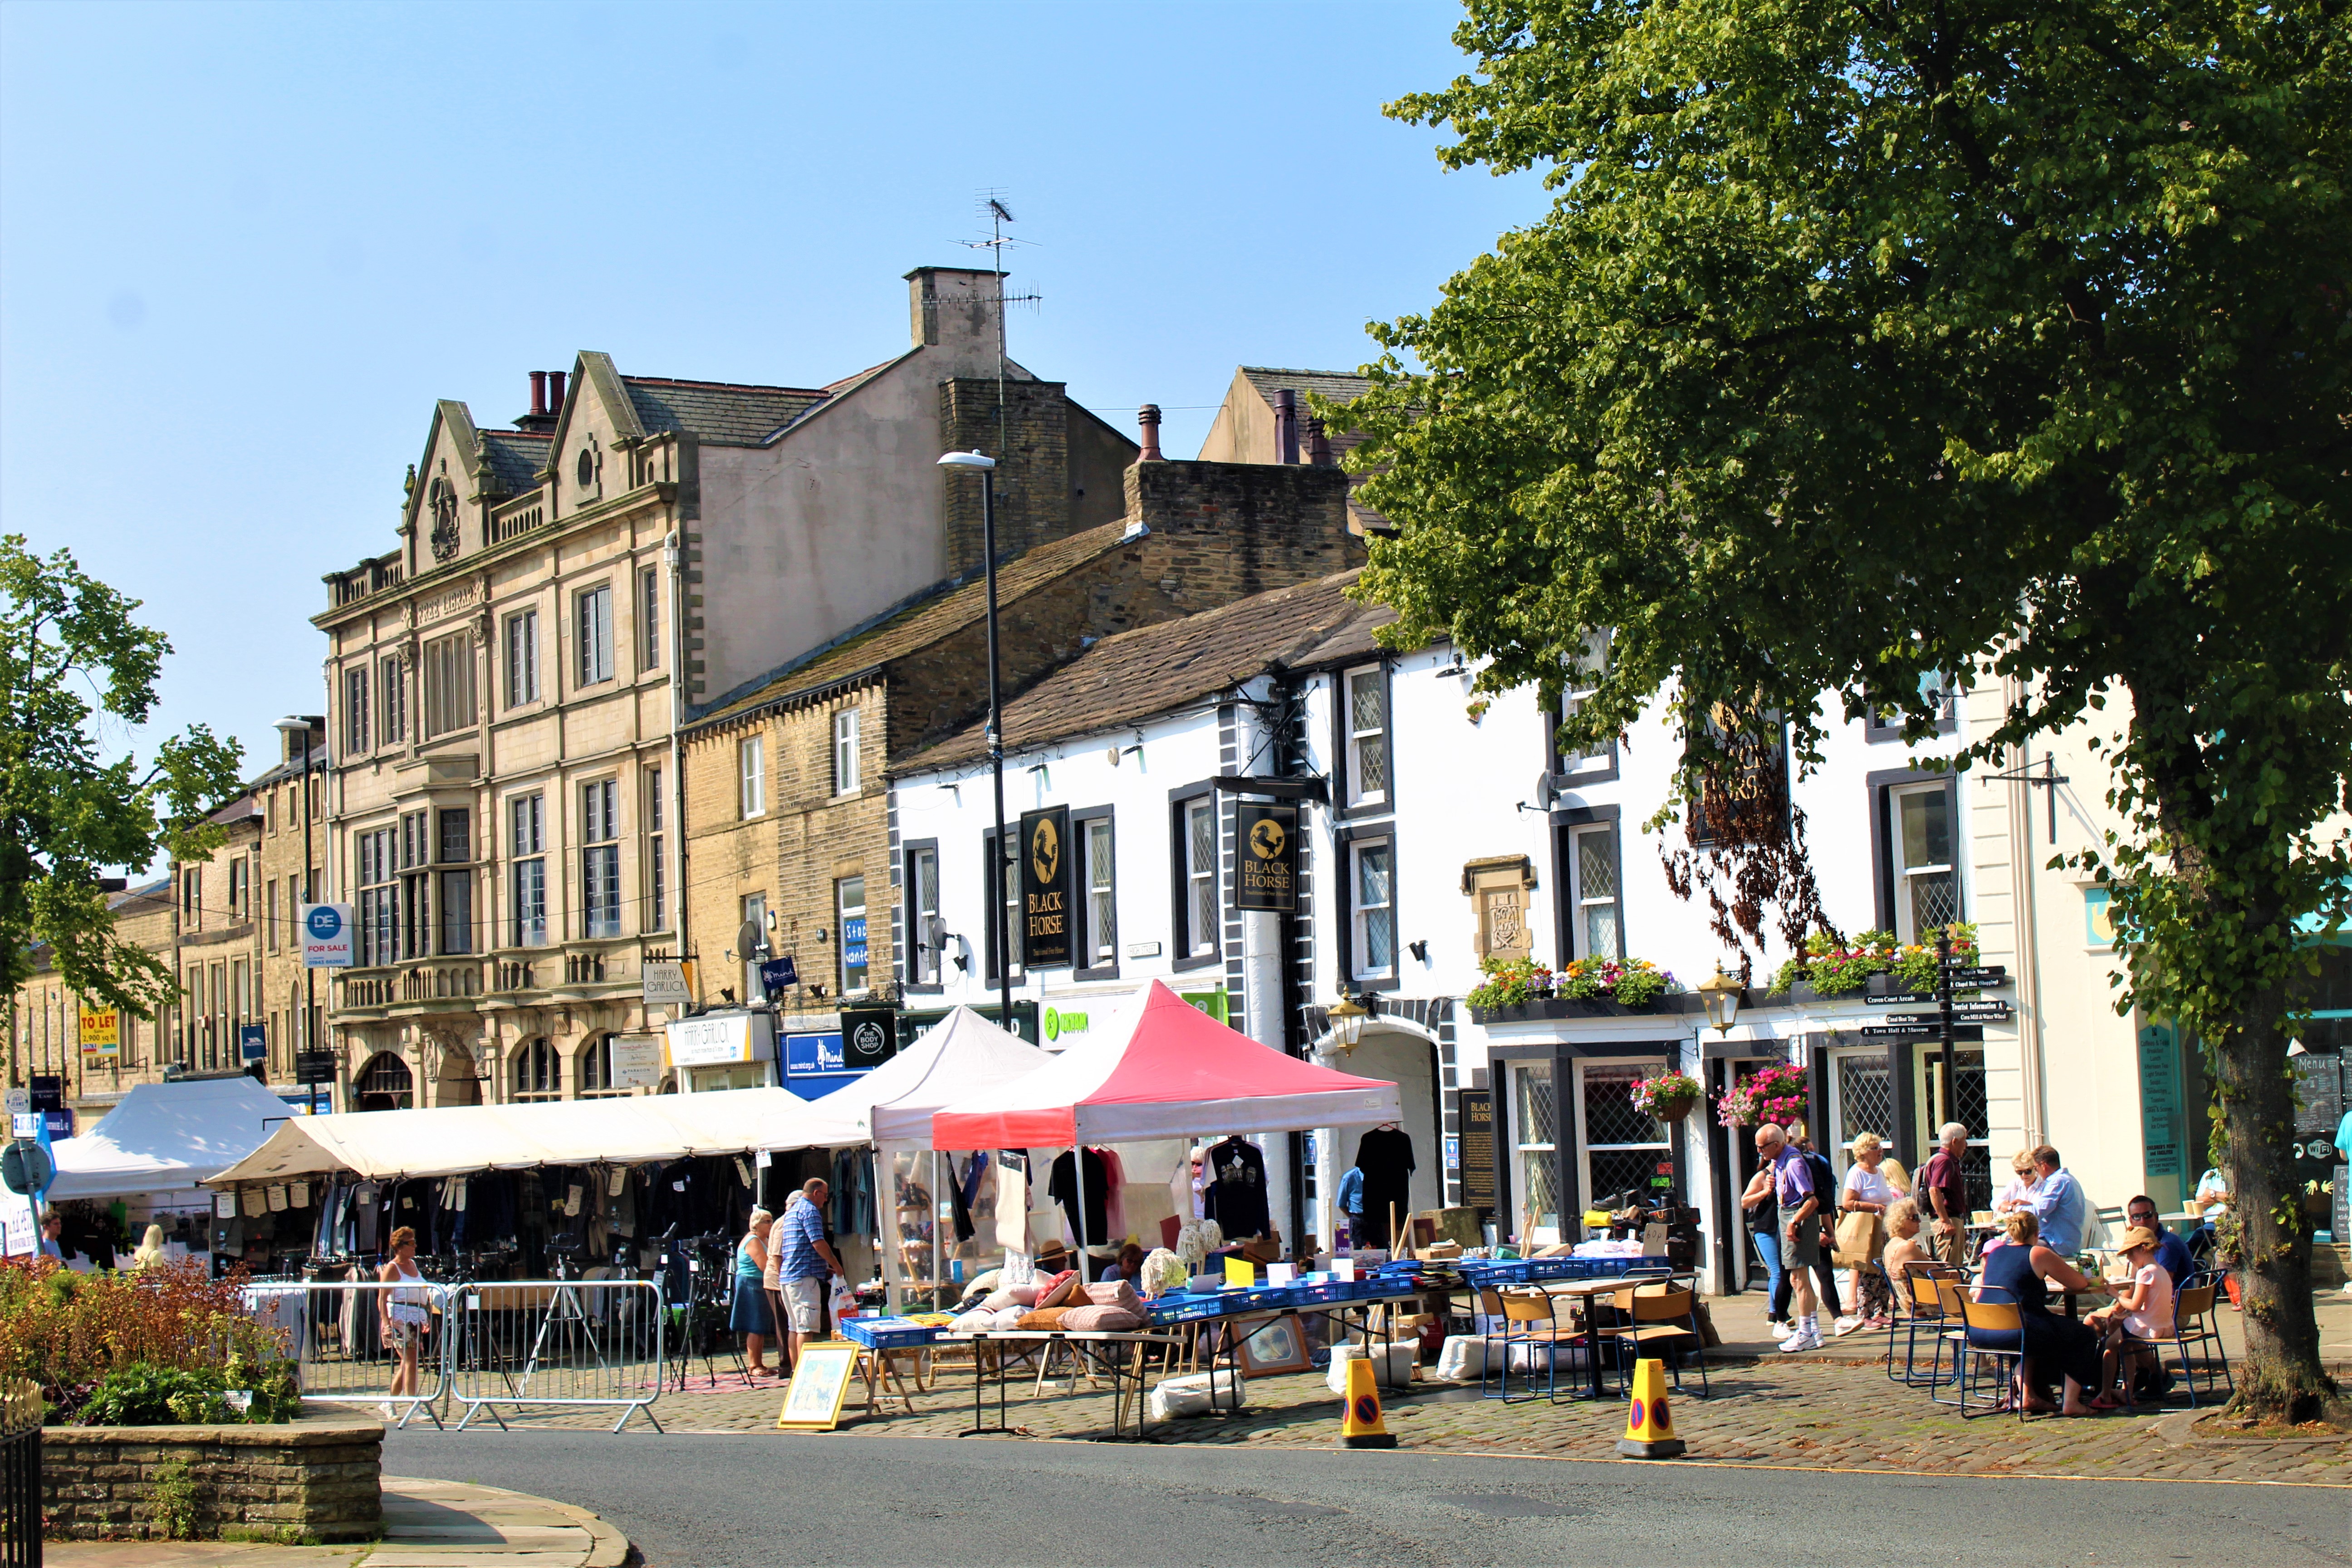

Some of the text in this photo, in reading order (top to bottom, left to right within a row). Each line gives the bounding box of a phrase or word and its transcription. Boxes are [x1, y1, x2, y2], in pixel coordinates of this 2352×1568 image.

[417, 581, 481, 624] FREE LIBRARY
[1245, 860, 1289, 874] BLACK
[1245, 874, 1289, 888] HORSE
[1029, 892, 1063, 914] BLACK
[314, 915, 334, 928] DE
[1029, 915, 1064, 936] HORSE
[1129, 945, 1156, 955] HIGH STREET
[654, 969, 677, 980] HARRY
[772, 968, 794, 978] mind
[647, 981, 685, 992] GARLICK
[1969, 1002, 1996, 1010] Information
[82, 1015, 115, 1029] TO LET
[1060, 1012, 1088, 1033] OXFAM
[684, 1022, 729, 1046] HARRY GARLICK
[2299, 1058, 2327, 1071] Menu
[1646, 1230, 1662, 1242] 60p
